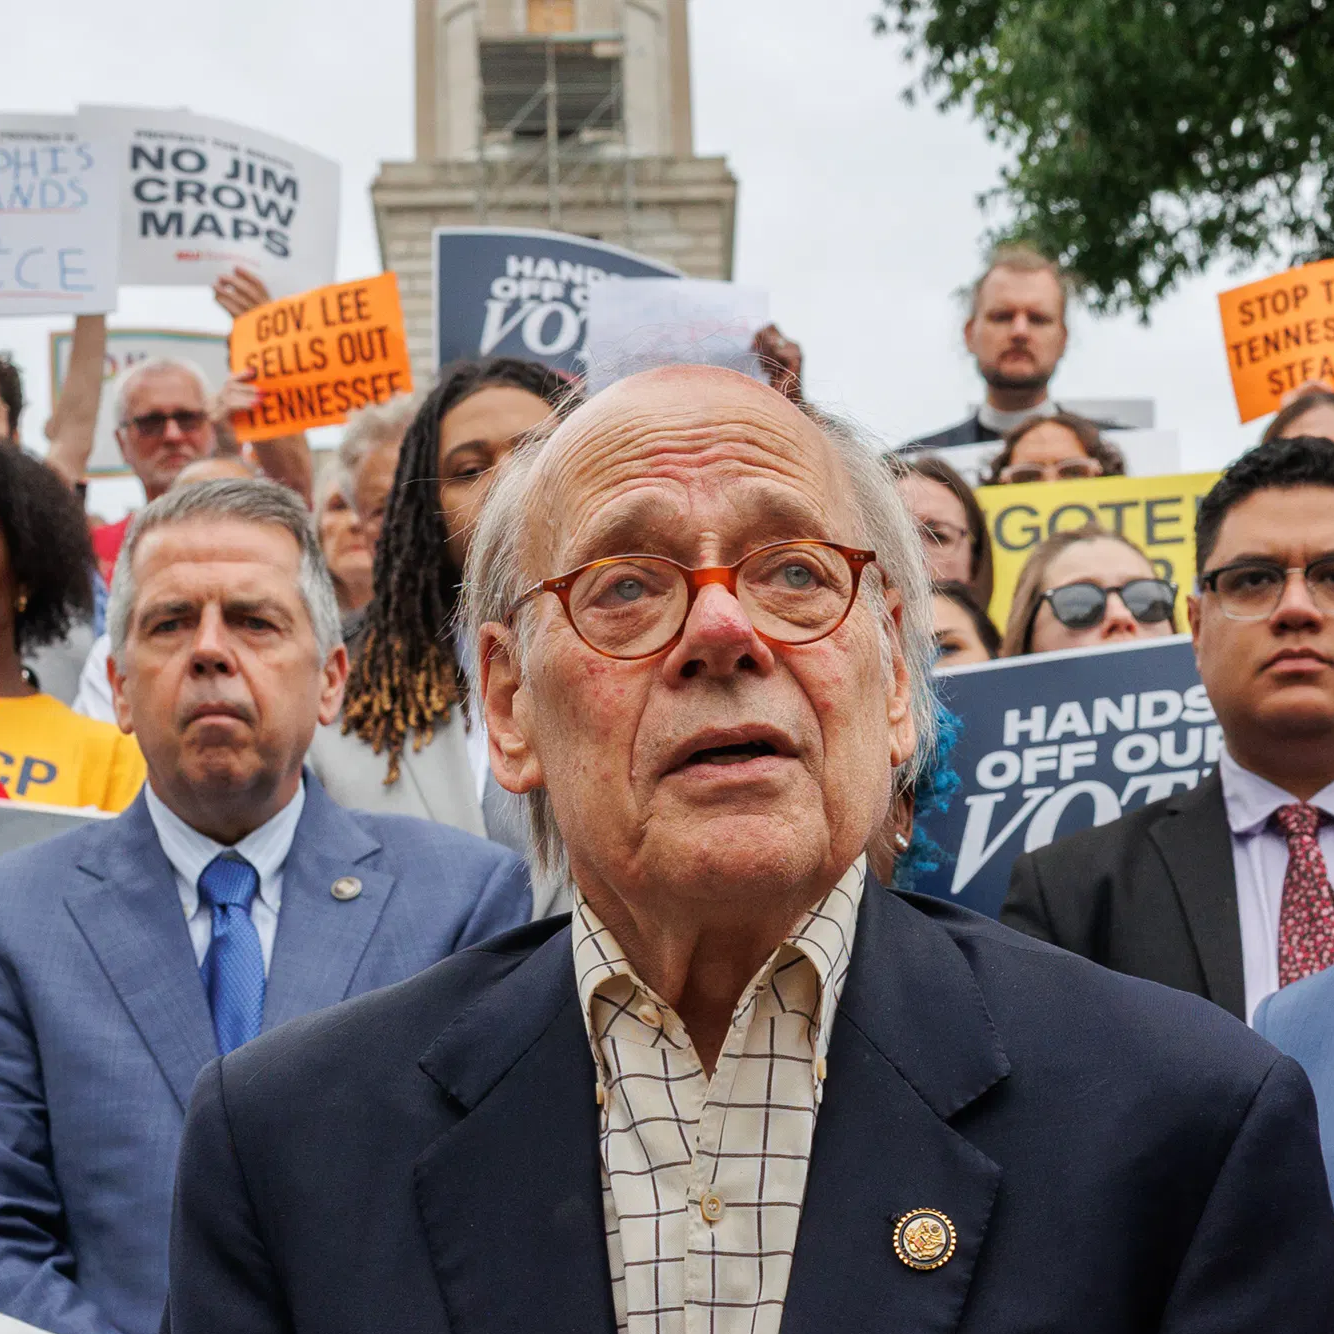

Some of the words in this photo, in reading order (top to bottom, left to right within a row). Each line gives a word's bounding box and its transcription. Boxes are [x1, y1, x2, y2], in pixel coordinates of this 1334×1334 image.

[130, 146, 208, 174] NO
[225, 159, 300, 201] JIM
[133, 177, 295, 228] CROW
[140, 210, 292, 258] MAPS
[256, 302, 313, 343] GOV.
[321, 287, 373, 329] LEE
[490, 276, 565, 303] OFF
[1237, 283, 1309, 327] STOP
[245, 334, 330, 382] SELLS
[338, 326, 389, 367] OUT
[1002, 689, 1214, 746] HANDS
[975, 739, 1098, 790] OFF
